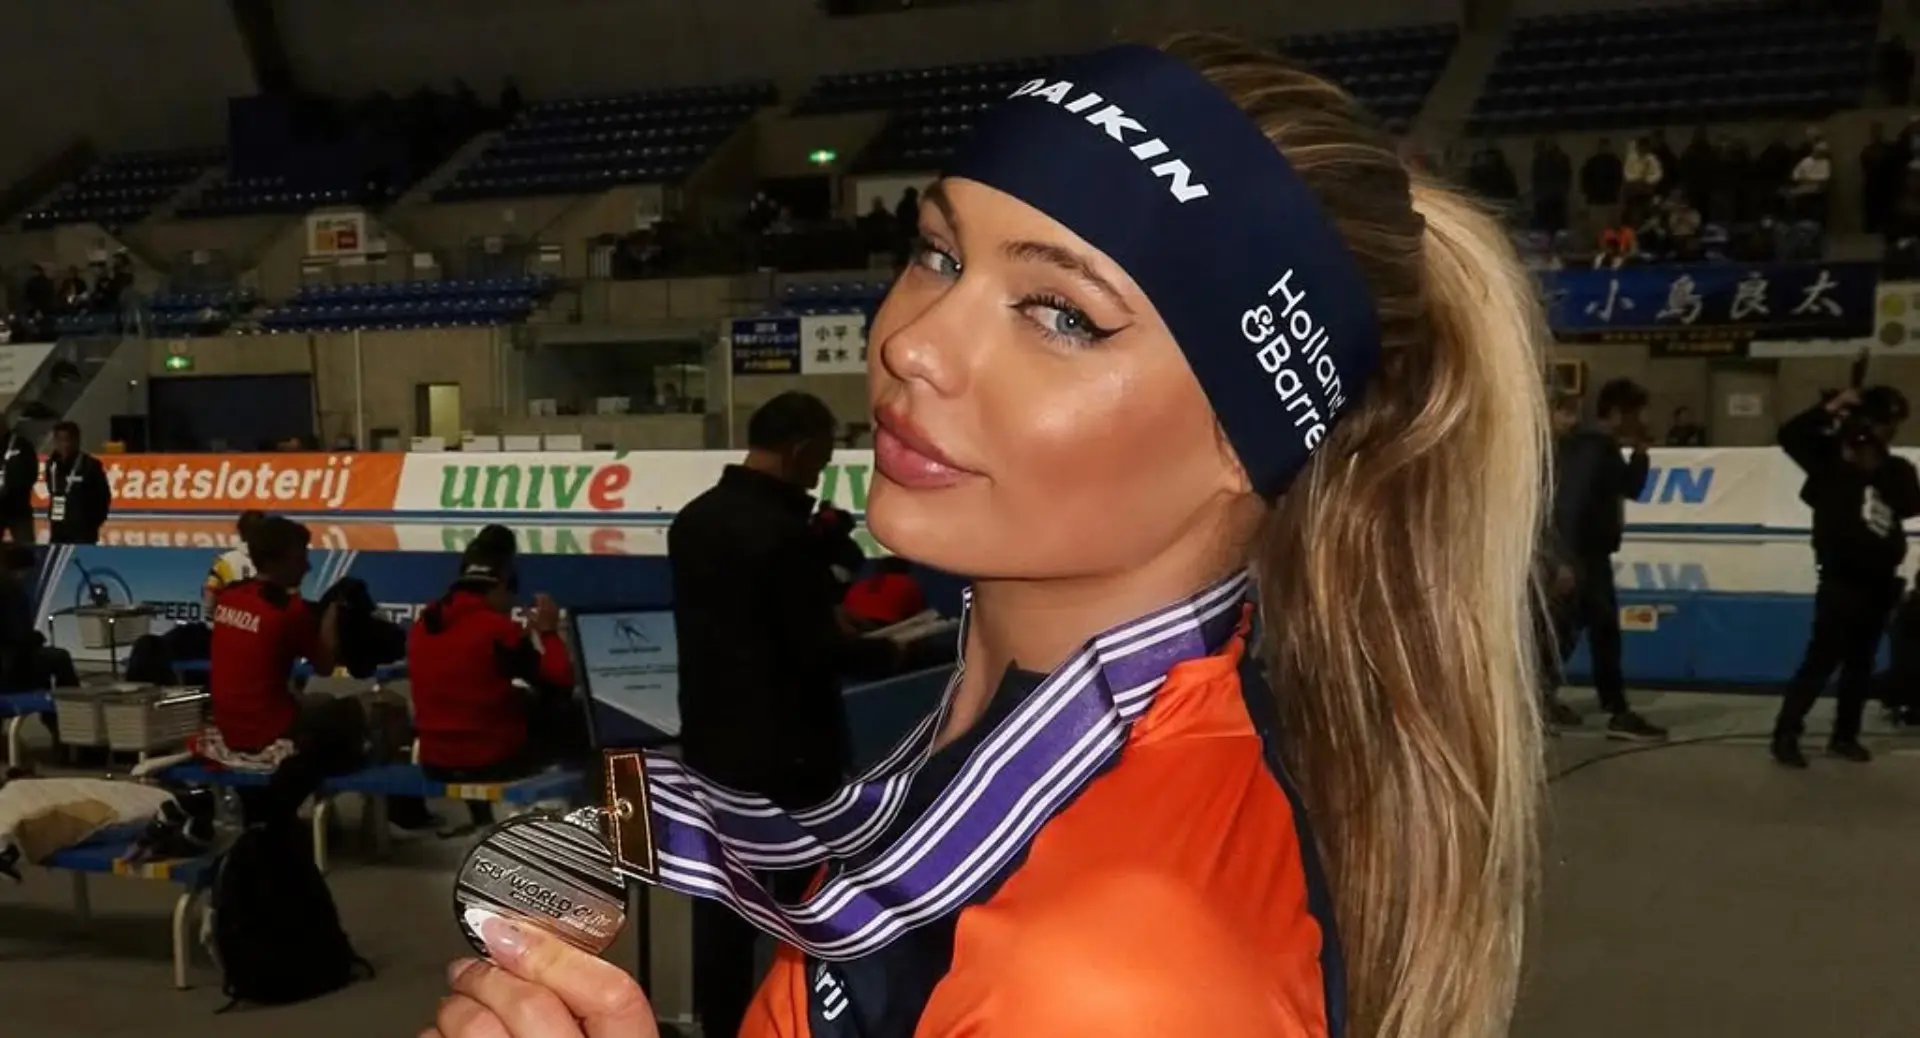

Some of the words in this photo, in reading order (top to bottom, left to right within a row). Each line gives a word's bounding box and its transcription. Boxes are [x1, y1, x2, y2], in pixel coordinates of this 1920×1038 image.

[1007, 78, 1209, 203] DAIKIN
[1241, 304, 1327, 451] &Barre
[106, 456, 352, 508] taatsloterij
[214, 603, 261, 634] CANADA
